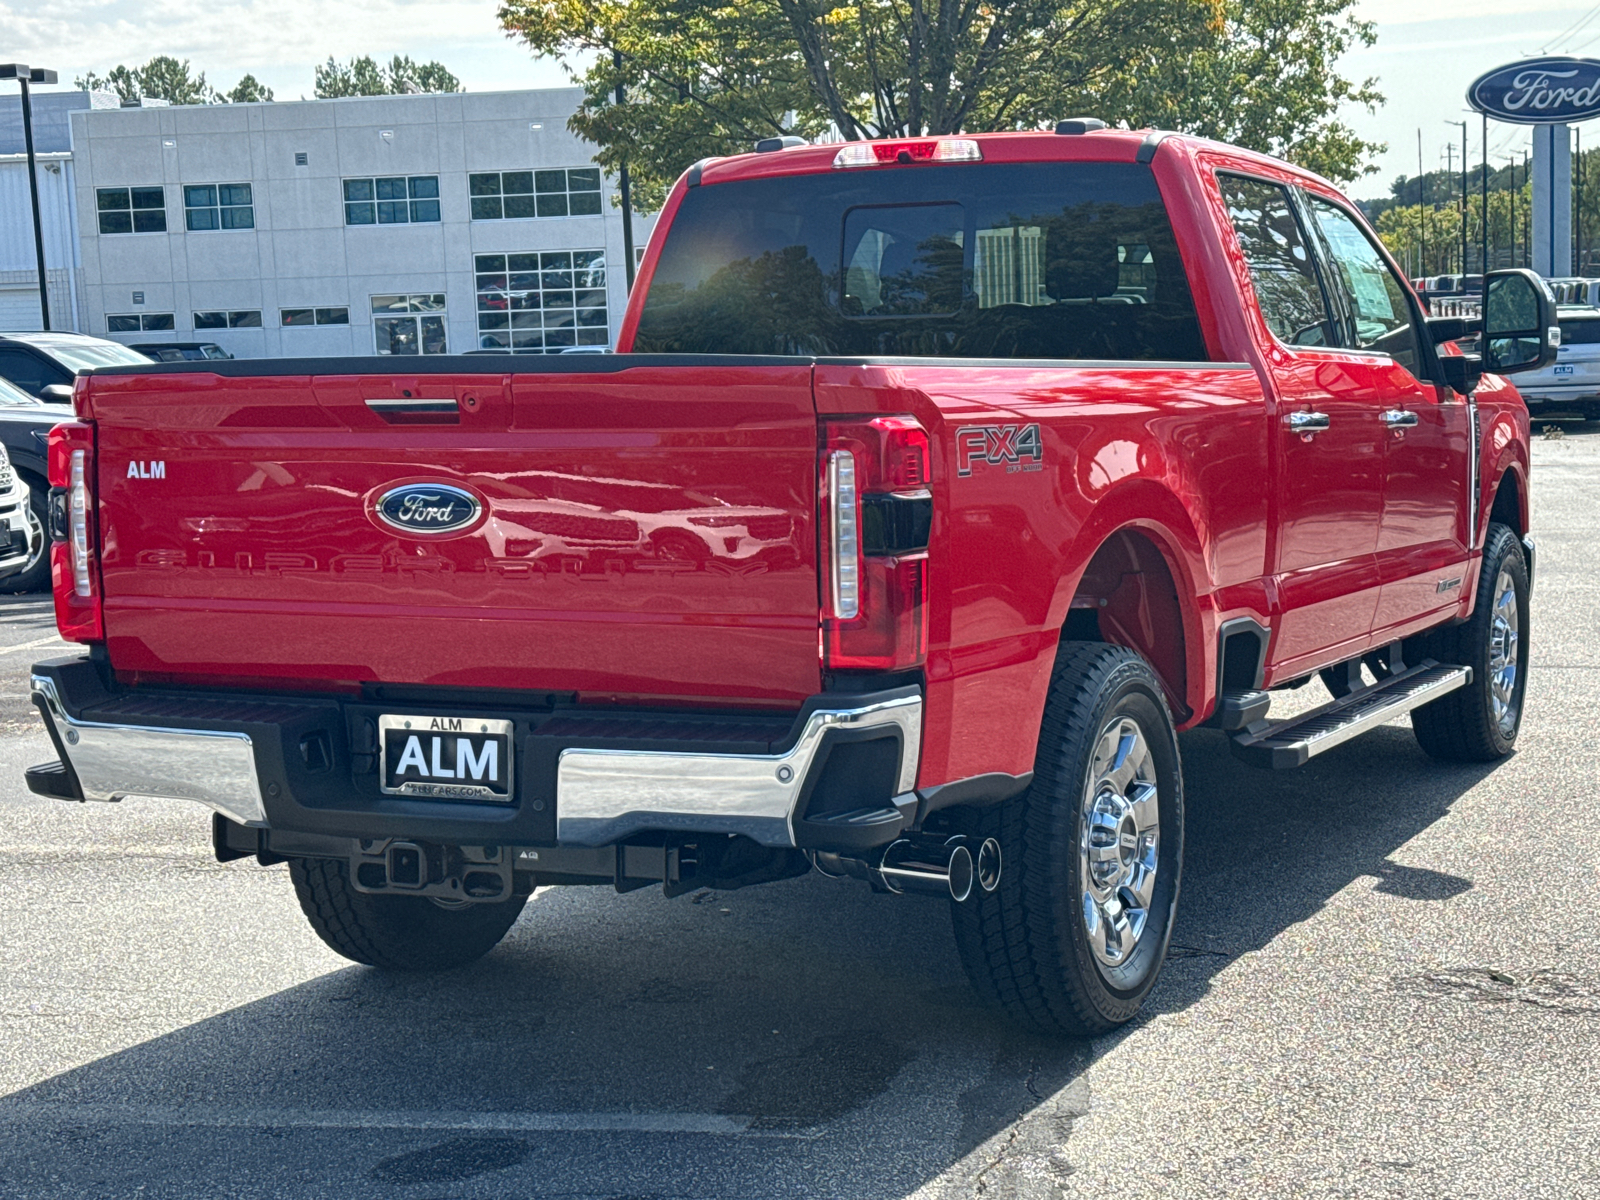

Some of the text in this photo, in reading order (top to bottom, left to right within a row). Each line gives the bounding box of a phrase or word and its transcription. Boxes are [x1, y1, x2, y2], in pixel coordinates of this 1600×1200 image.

[1503, 70, 1600, 110] Ford
[955, 423, 1043, 478] FX4
[127, 460, 166, 479] ALM
[398, 494, 455, 522] Ford
[430, 717, 463, 731] ALM
[395, 735, 498, 782] ALM
